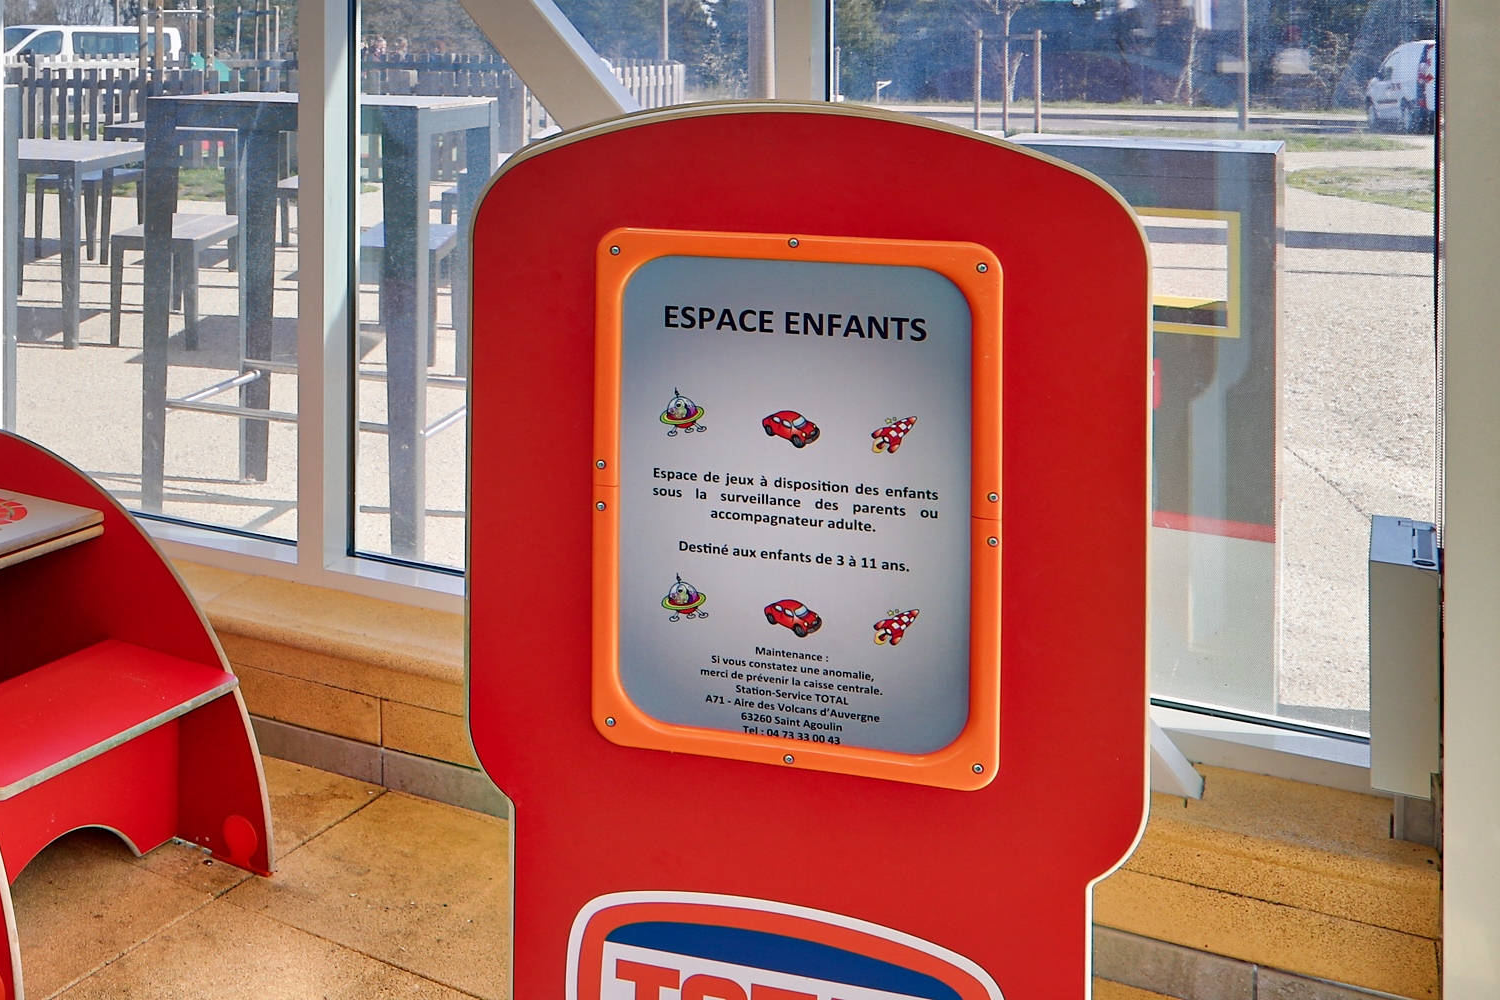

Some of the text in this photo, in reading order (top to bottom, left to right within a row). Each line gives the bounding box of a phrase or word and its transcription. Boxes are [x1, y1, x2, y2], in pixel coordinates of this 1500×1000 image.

[664, 305, 927, 342] ESPACE ENFANTS
[653, 467, 939, 501] Espace de jeux à disposition des enfants
[652, 487, 939, 520] sous la surveillance des parents ou
[710, 509, 876, 533] accompagnateur adulte.
[678, 540, 910, 573] Destiné aux enfants de 3 à 11 ans.
[755, 646, 823, 662] Maintenance
[711, 654, 875, 683] Si vous constatez une anomalie,
[700, 668, 883, 696] merci de prévenir la caisse centrale.
[735, 684, 849, 706] Station-Service TOTAL
[705, 694, 725, 705] A71
[733, 697, 755, 709] Aire
[757, 700, 776, 711] des
[777, 702, 818, 716] Volcans
[740, 711, 843, 732] 63260 Saint Agoulin
[742, 725, 759, 736] Tel
[766, 728, 780, 738] 04
[781, 730, 795, 740] 73
[797, 732, 810, 742] 33
[811, 733, 826, 744] 00
[827, 735, 841, 746] 43
